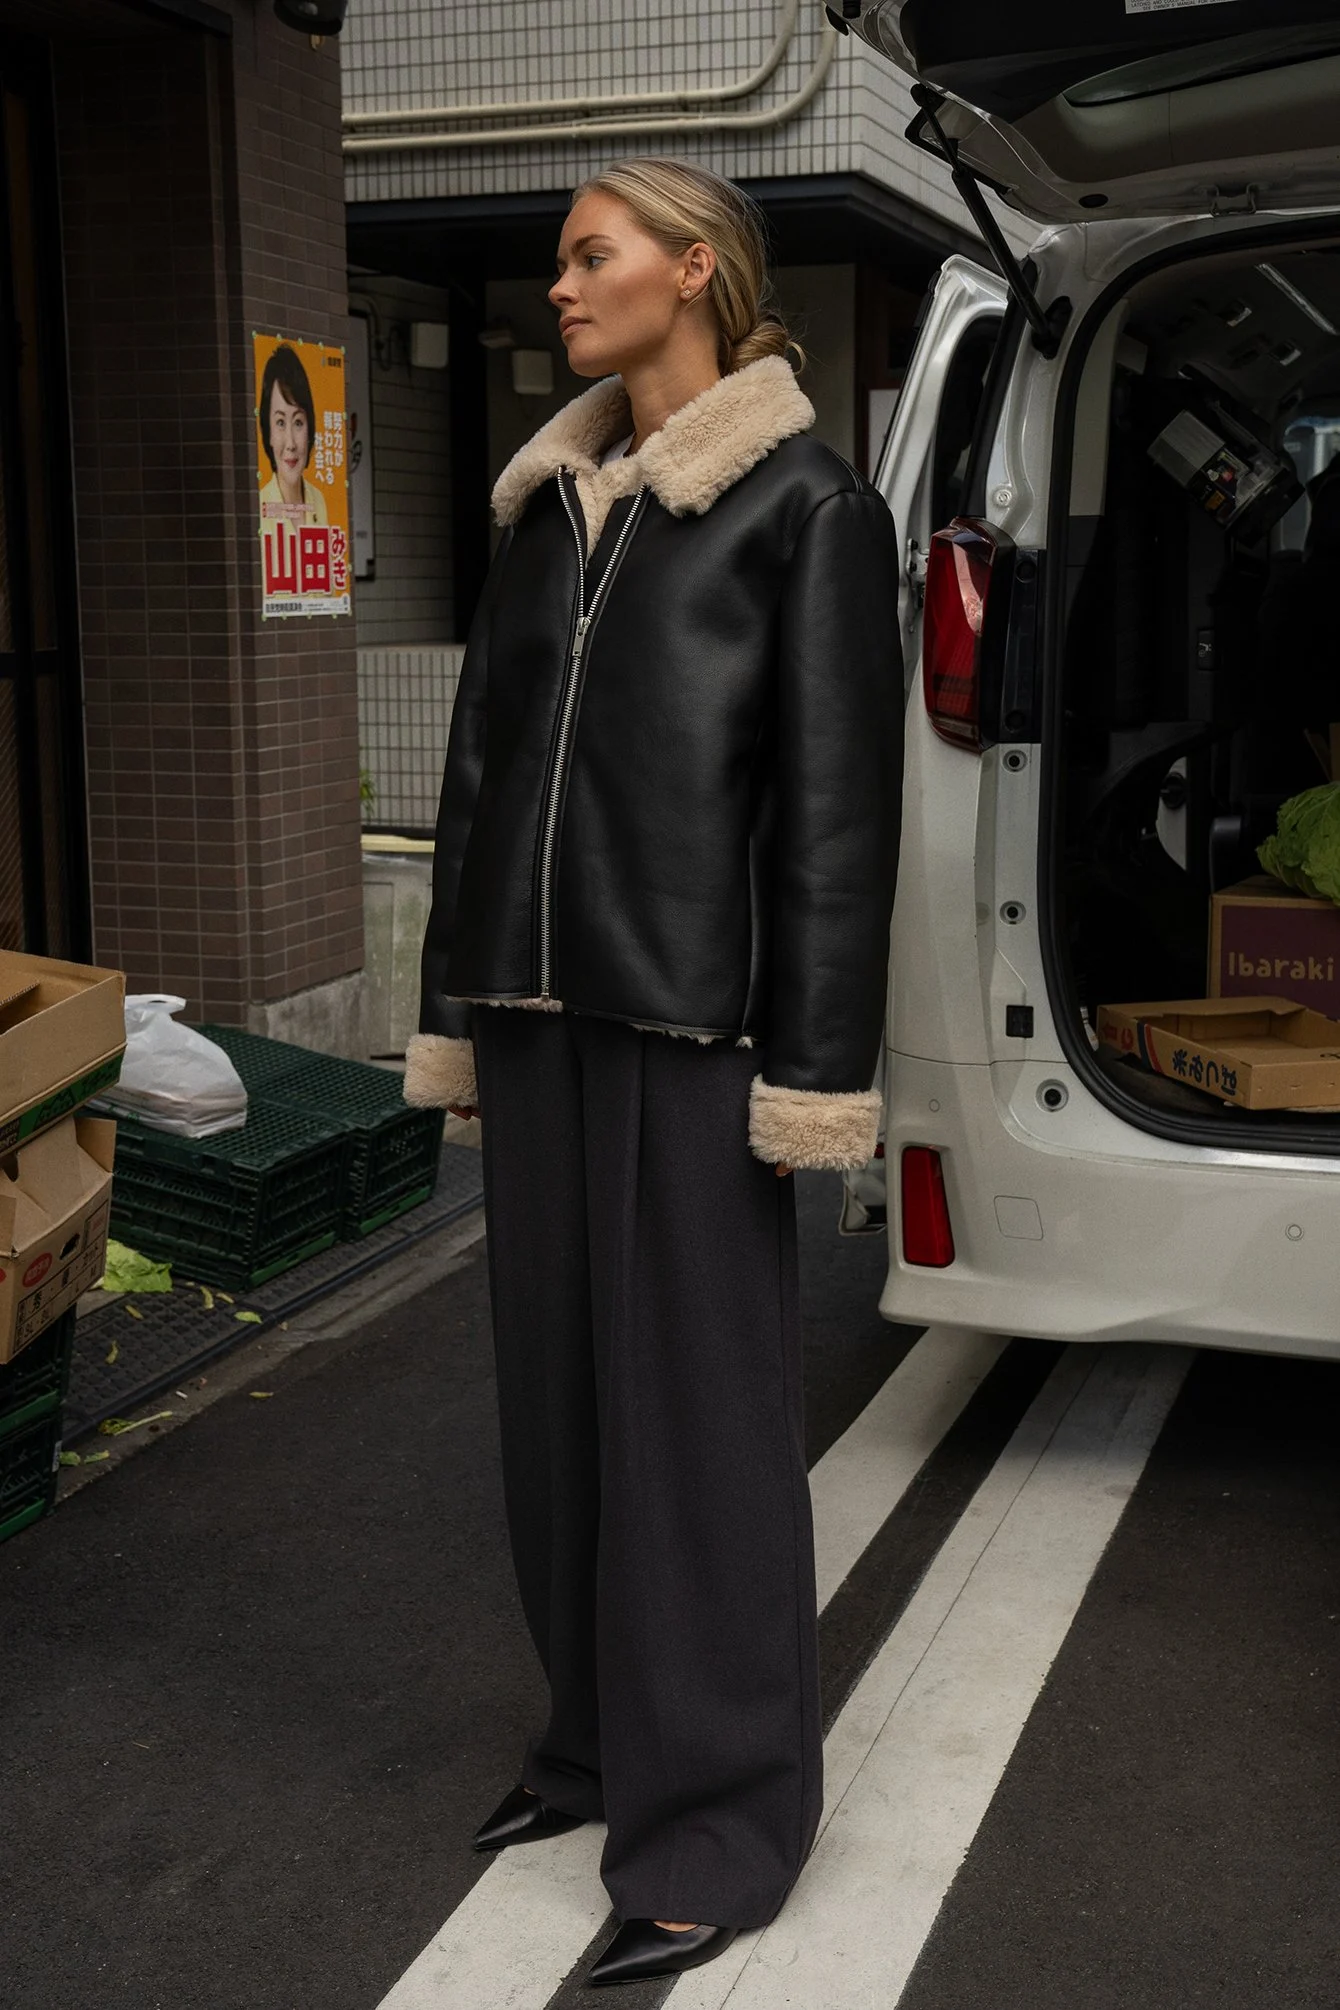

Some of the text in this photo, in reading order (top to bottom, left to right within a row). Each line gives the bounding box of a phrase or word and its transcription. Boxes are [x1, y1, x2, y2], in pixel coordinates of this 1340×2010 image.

[314, 432, 325, 482] 社会へ
[323, 411, 335, 485] 報われる
[333, 411, 344, 467] 努力が
[263, 522, 346, 595] 山田 みき
[1228, 951, 1335, 981] Ibaraki
